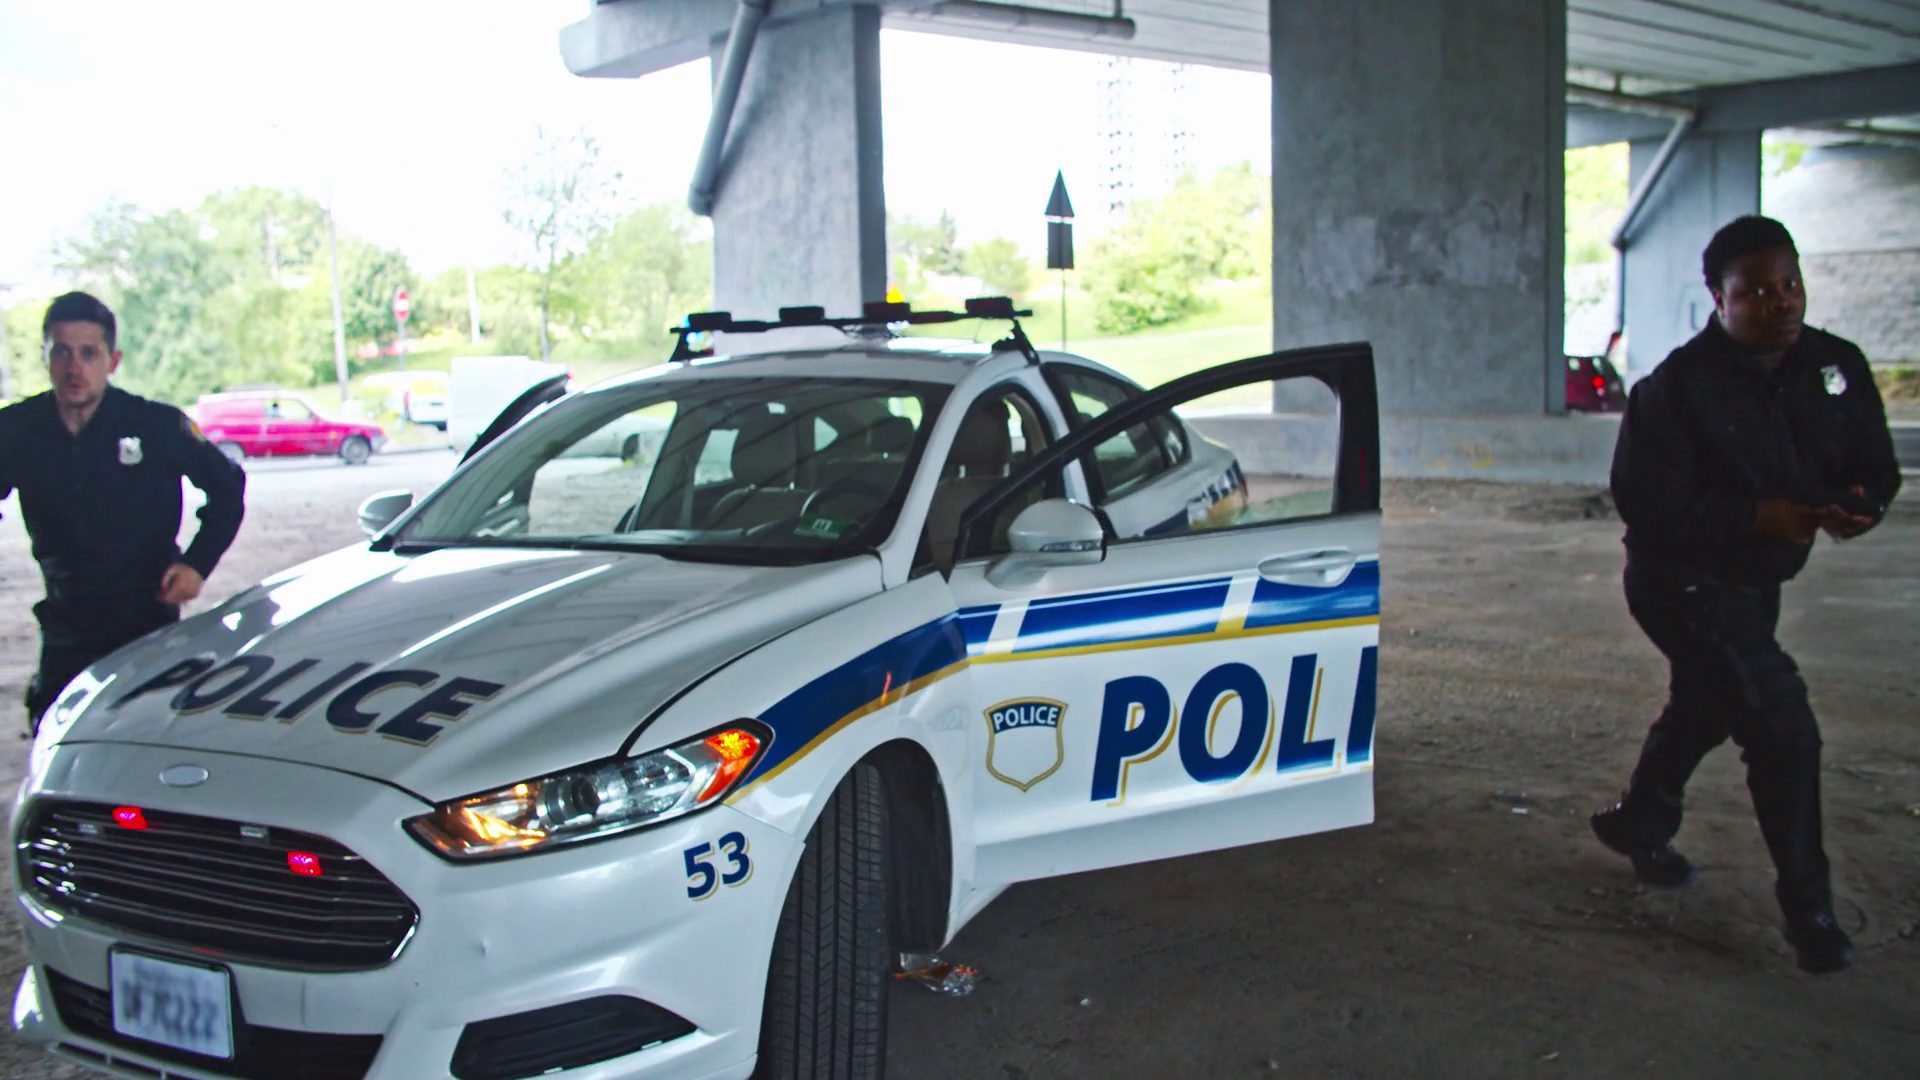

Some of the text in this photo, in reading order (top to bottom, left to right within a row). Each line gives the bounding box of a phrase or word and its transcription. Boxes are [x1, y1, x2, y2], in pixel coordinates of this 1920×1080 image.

[106, 654, 506, 747] POLICE
[992, 705, 1059, 731] POLICE
[1090, 645, 1378, 806] POLI
[683, 830, 754, 902] 53
